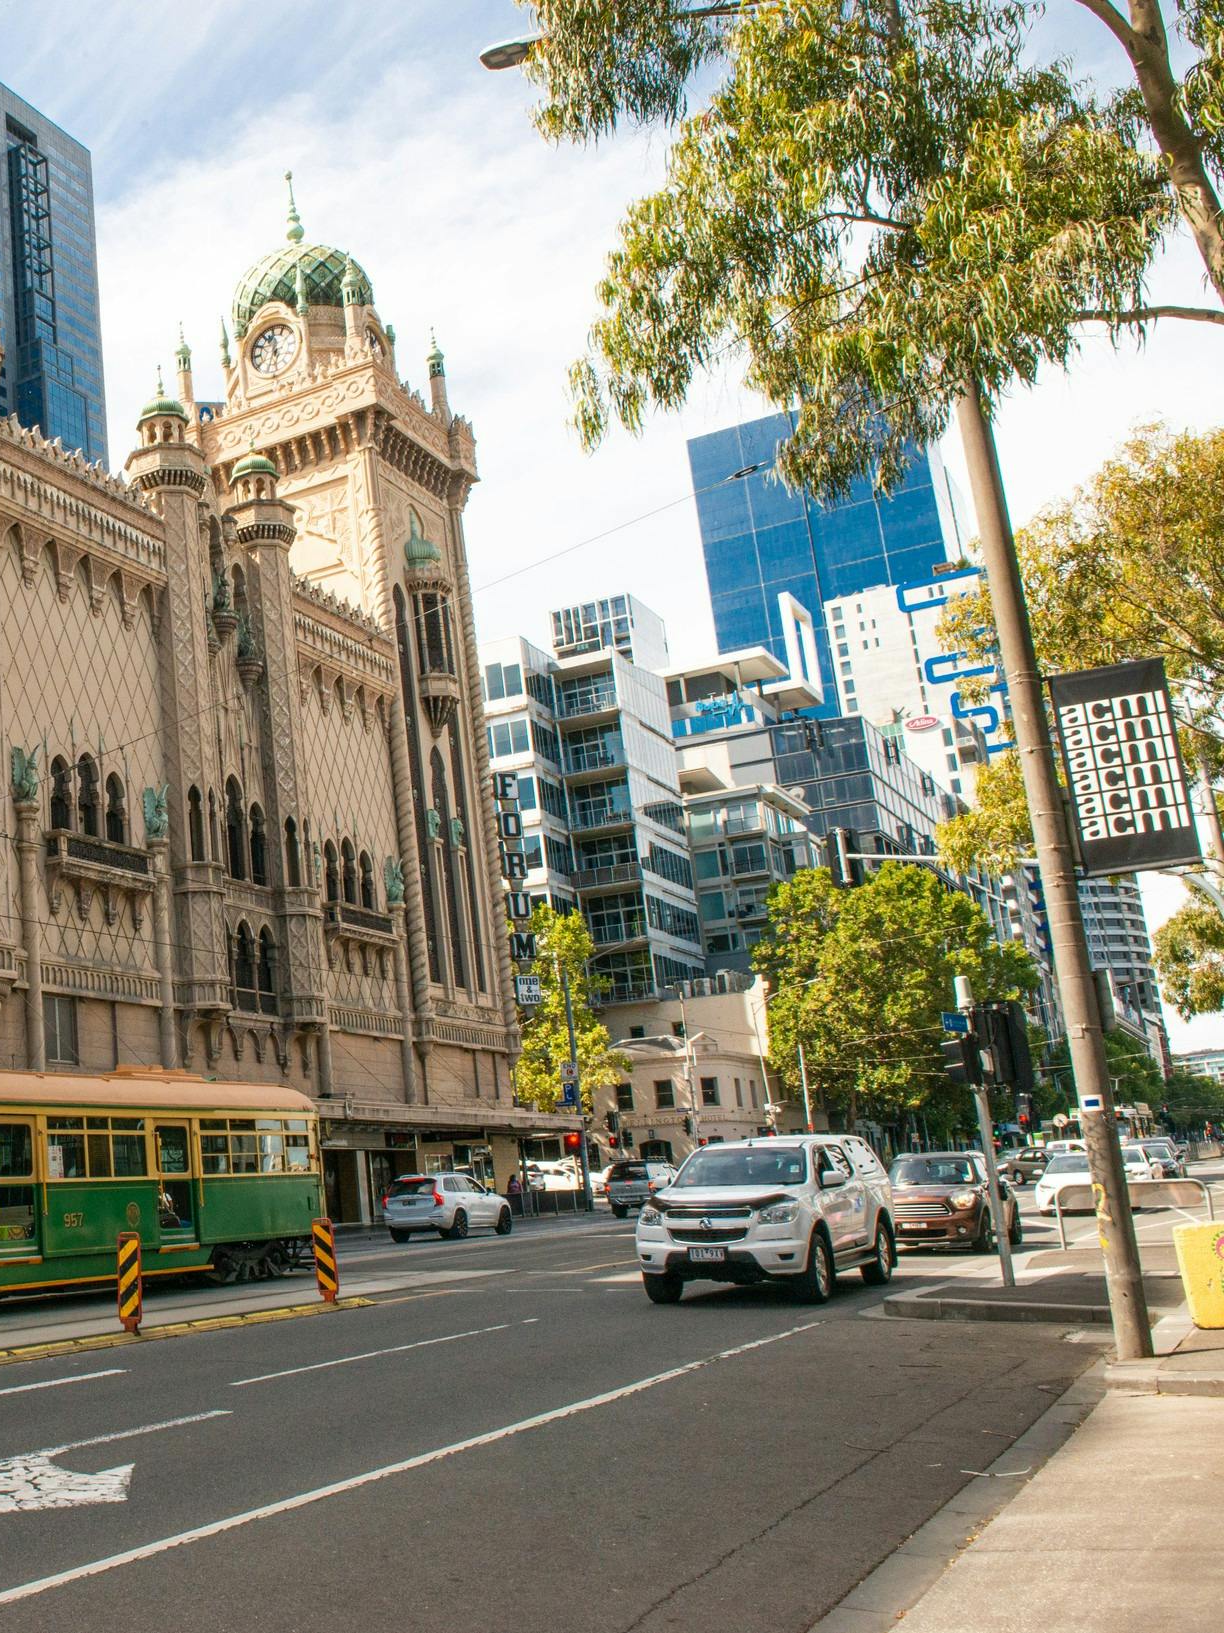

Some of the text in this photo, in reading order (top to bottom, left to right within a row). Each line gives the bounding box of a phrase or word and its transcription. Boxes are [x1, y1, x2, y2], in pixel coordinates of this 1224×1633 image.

[1059, 690, 1166, 728] acmi
[1063, 712, 1171, 750] acmi
[1068, 735, 1176, 773] acmi
[1072, 758, 1180, 796] acmi
[1076, 781, 1186, 818] acmi
[1080, 804, 1190, 841] acmi
[497, 772, 537, 960] FORUM
[519, 977, 538, 986] one
[520, 993, 540, 1002] two
[63, 1212, 84, 1229] 957
